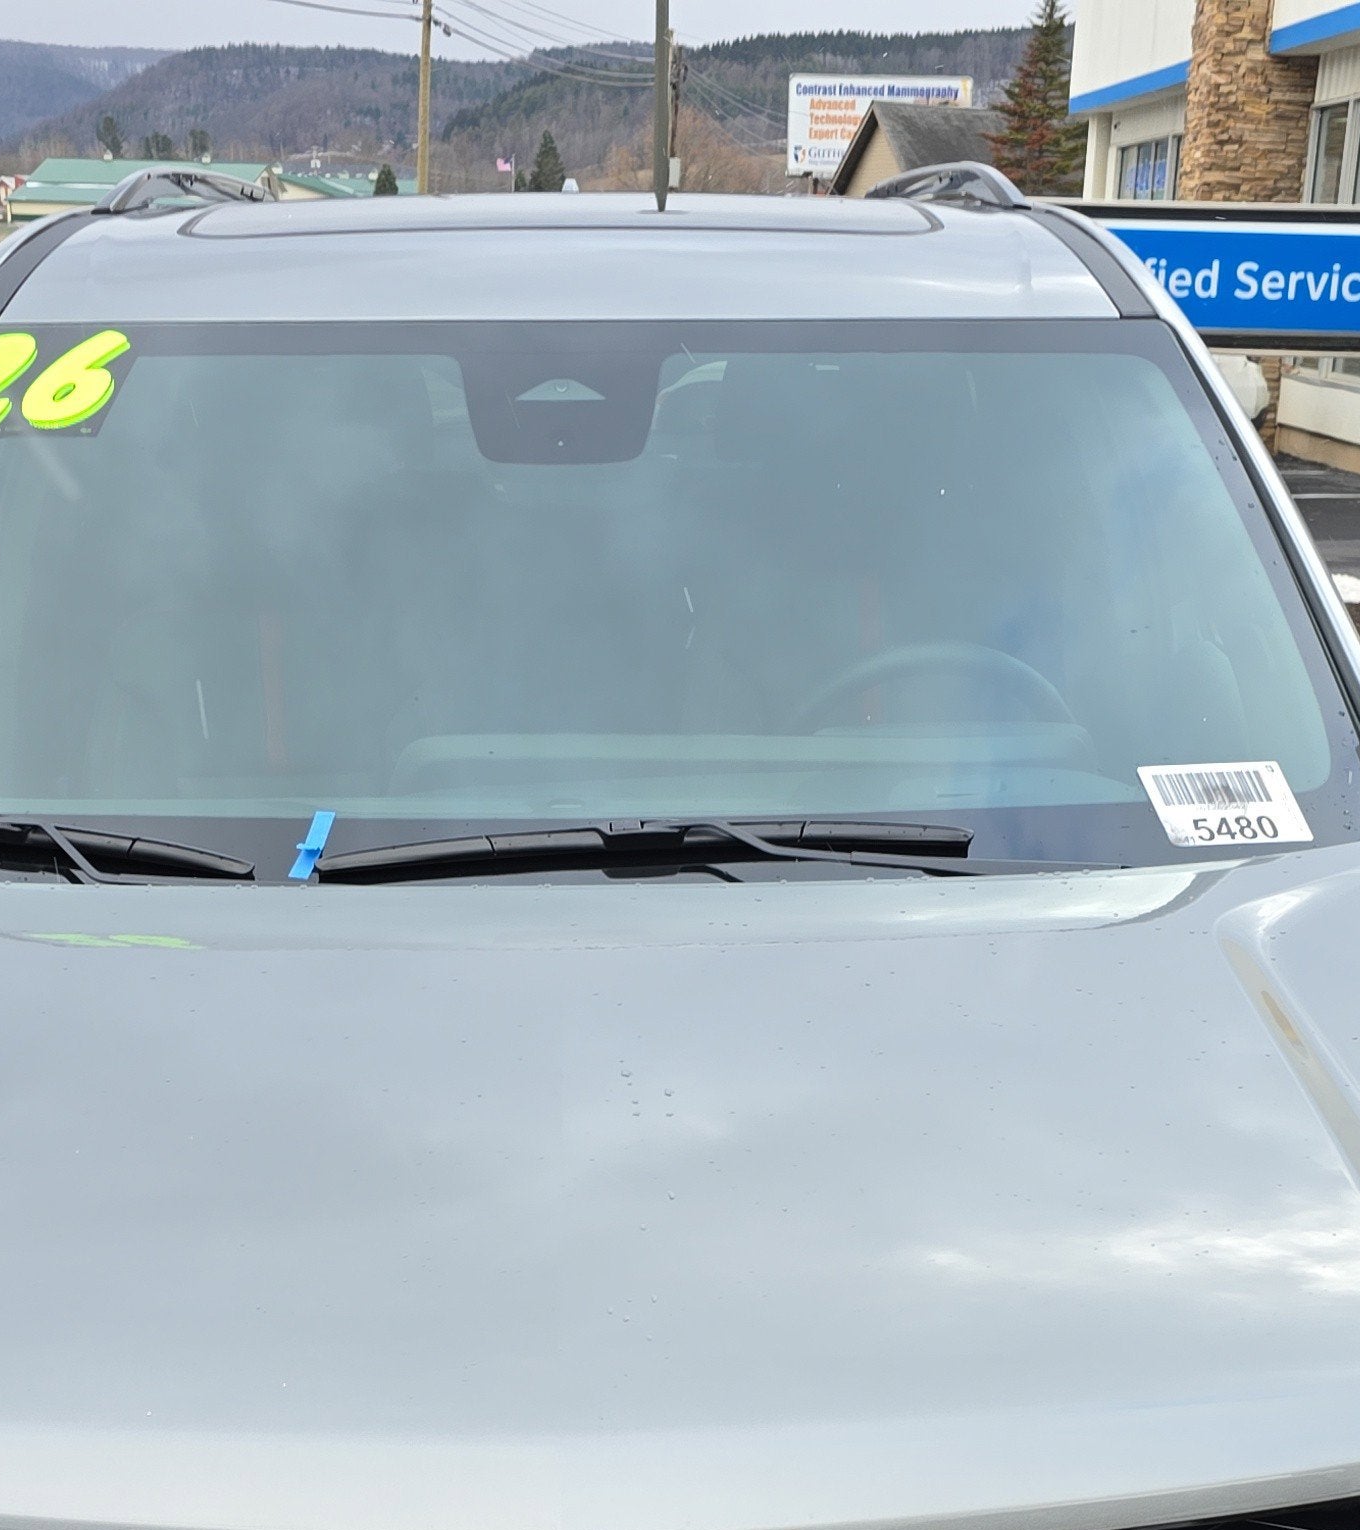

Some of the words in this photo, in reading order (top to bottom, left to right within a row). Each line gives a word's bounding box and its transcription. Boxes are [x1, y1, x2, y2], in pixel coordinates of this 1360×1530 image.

[796, 83, 837, 96] Contrast
[839, 84, 885, 97] Enhanced
[887, 85, 959, 100] Mammography
[809, 98, 856, 110] Advanced
[1192, 815, 1279, 842] 5480
